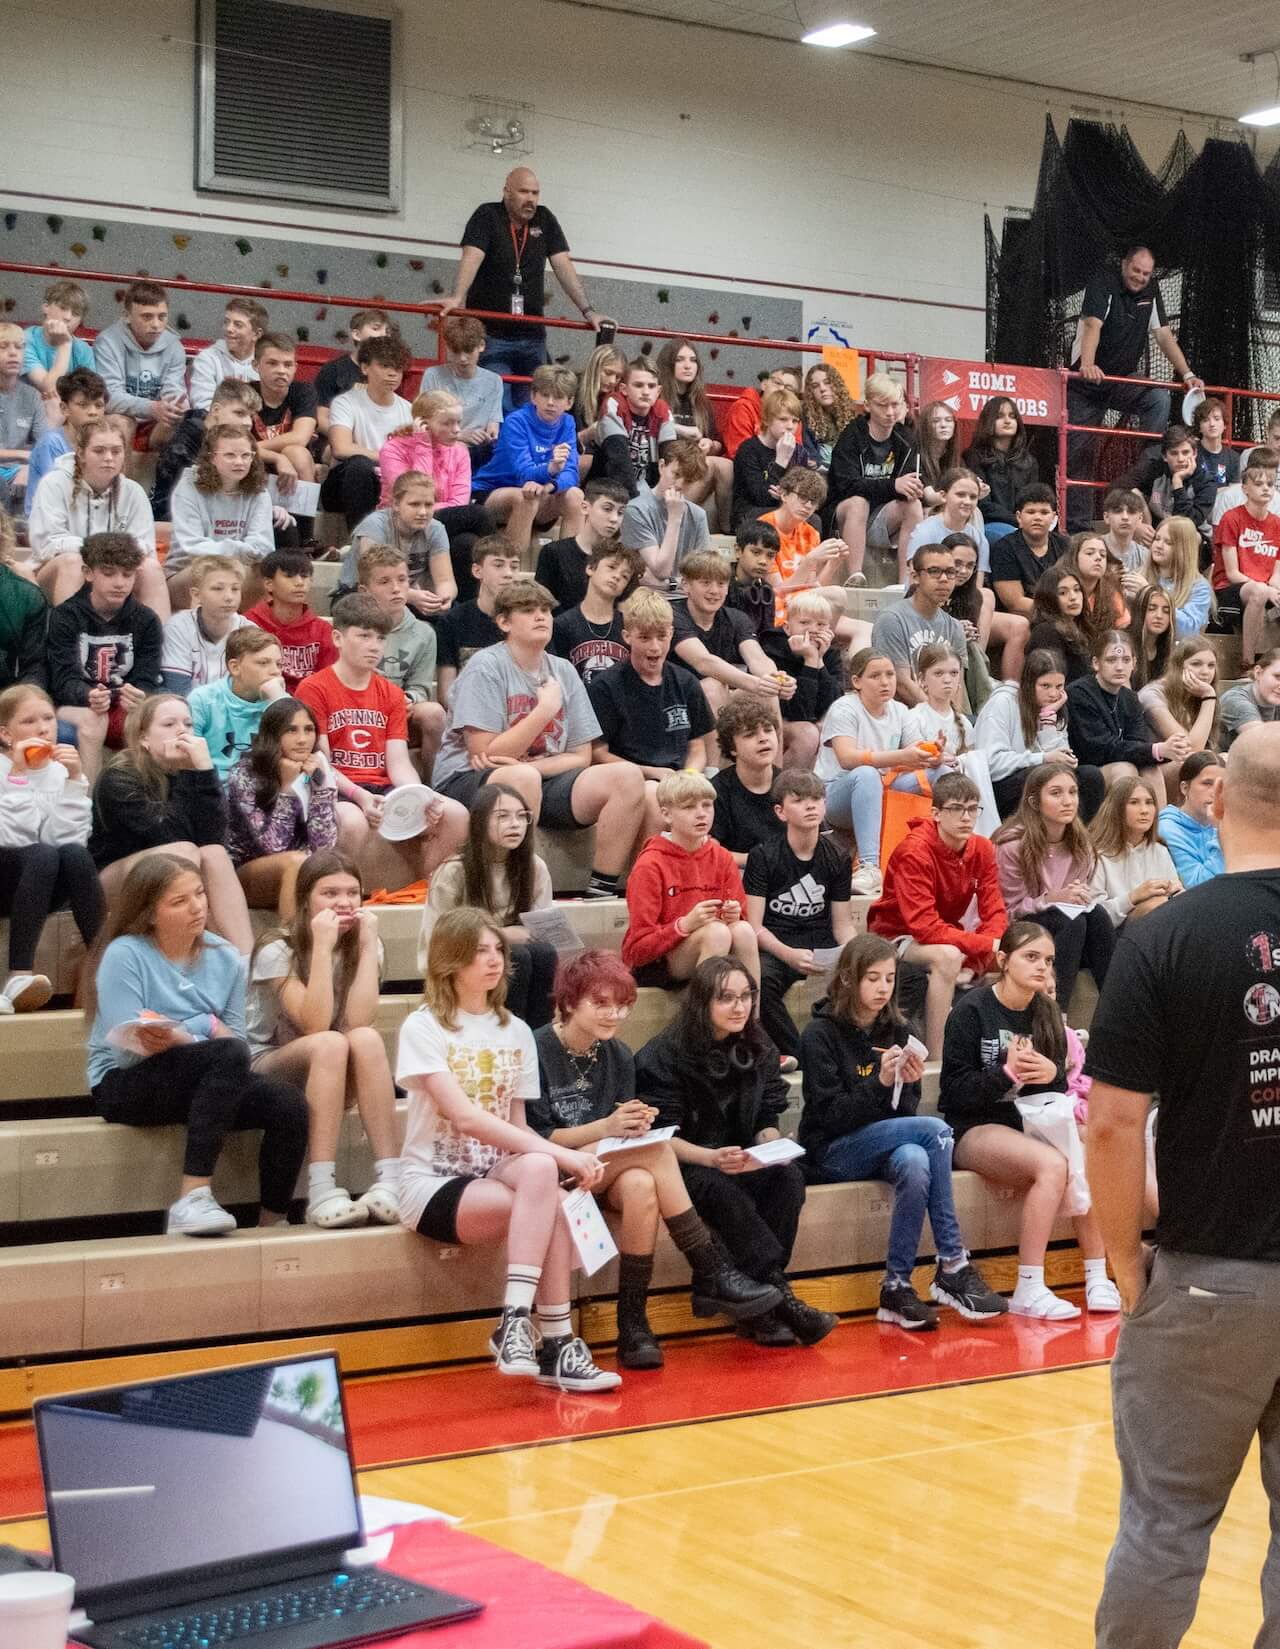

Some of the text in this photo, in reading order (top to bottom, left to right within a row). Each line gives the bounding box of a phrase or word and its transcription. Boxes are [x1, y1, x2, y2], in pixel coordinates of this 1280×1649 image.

[969, 371, 1017, 393] HOME
[968, 393, 1048, 417] VIORS
[1244, 527, 1264, 541] JUST
[1254, 544, 1279, 558] DO IT
[351, 729, 373, 748] C
[769, 898, 825, 917] adidas
